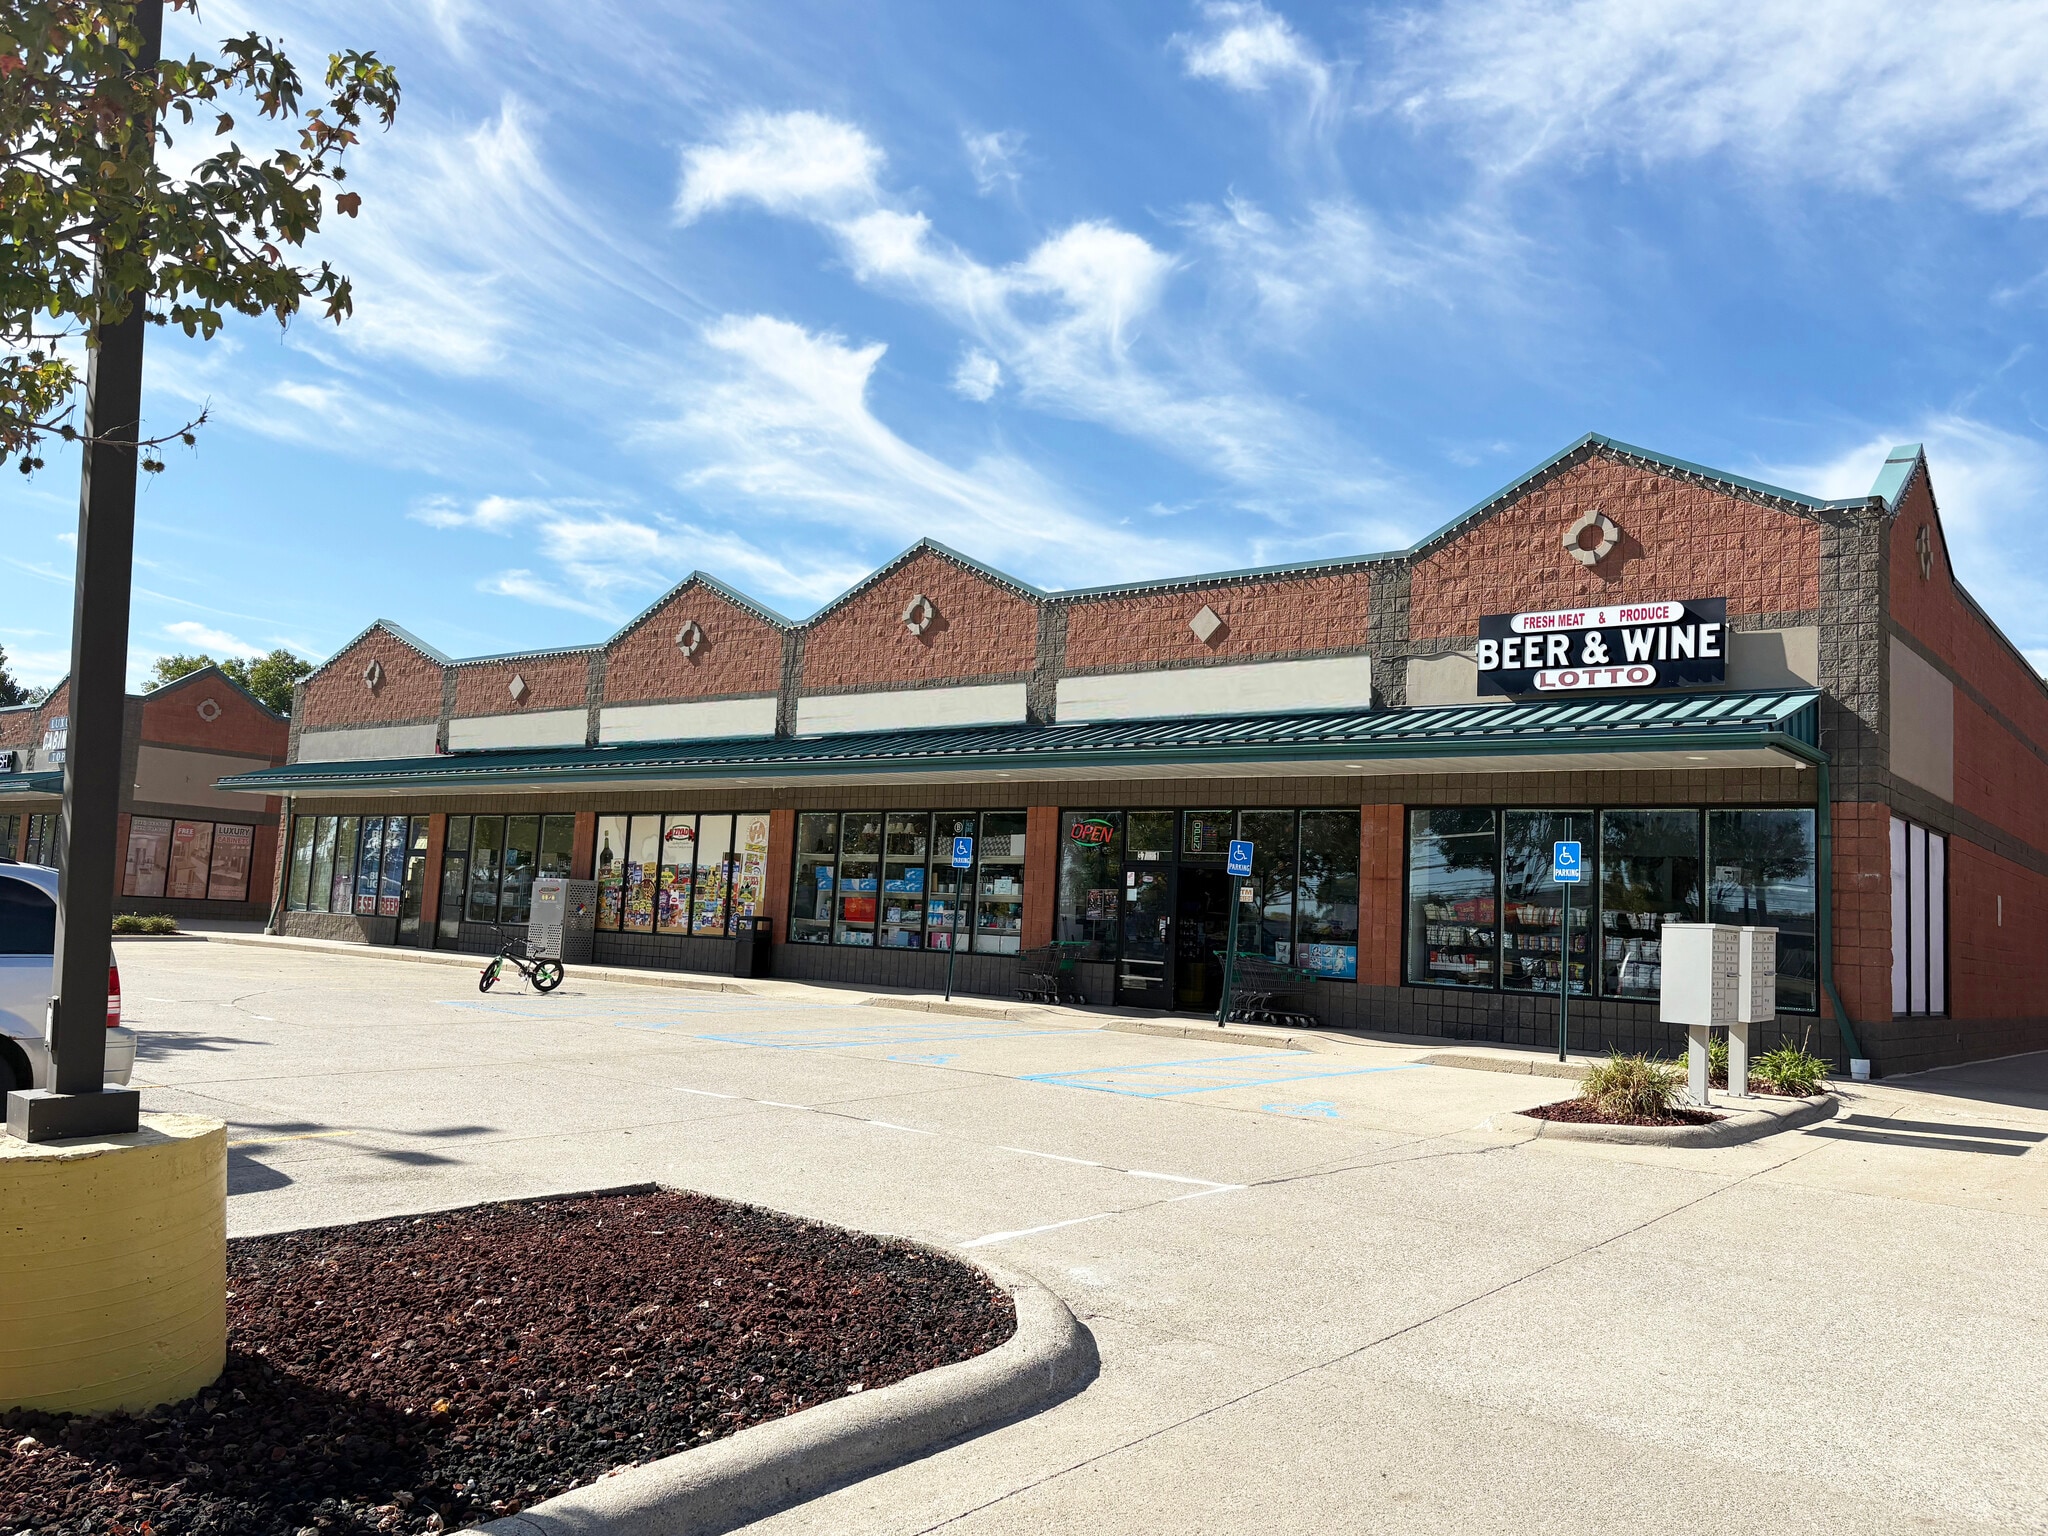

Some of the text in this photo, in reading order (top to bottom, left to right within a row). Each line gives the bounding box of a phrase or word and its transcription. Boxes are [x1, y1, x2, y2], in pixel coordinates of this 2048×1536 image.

[1523, 605, 1669, 629] FRESH MEAT & PRODUCE
[1478, 622, 1721, 671] BEER & WINE
[1539, 667, 1649, 688] LOTTO
[43, 730, 68, 751] CABIN
[177, 827, 194, 835] FREE
[217, 836, 249, 845] CABINETS
[218, 826, 250, 836] LUXURY
[1070, 823, 1114, 843] OPEN
[1193, 822, 1201, 849] OPEN
[1229, 862, 1250, 872] PARKING
[1555, 868, 1579, 877] PARKING
